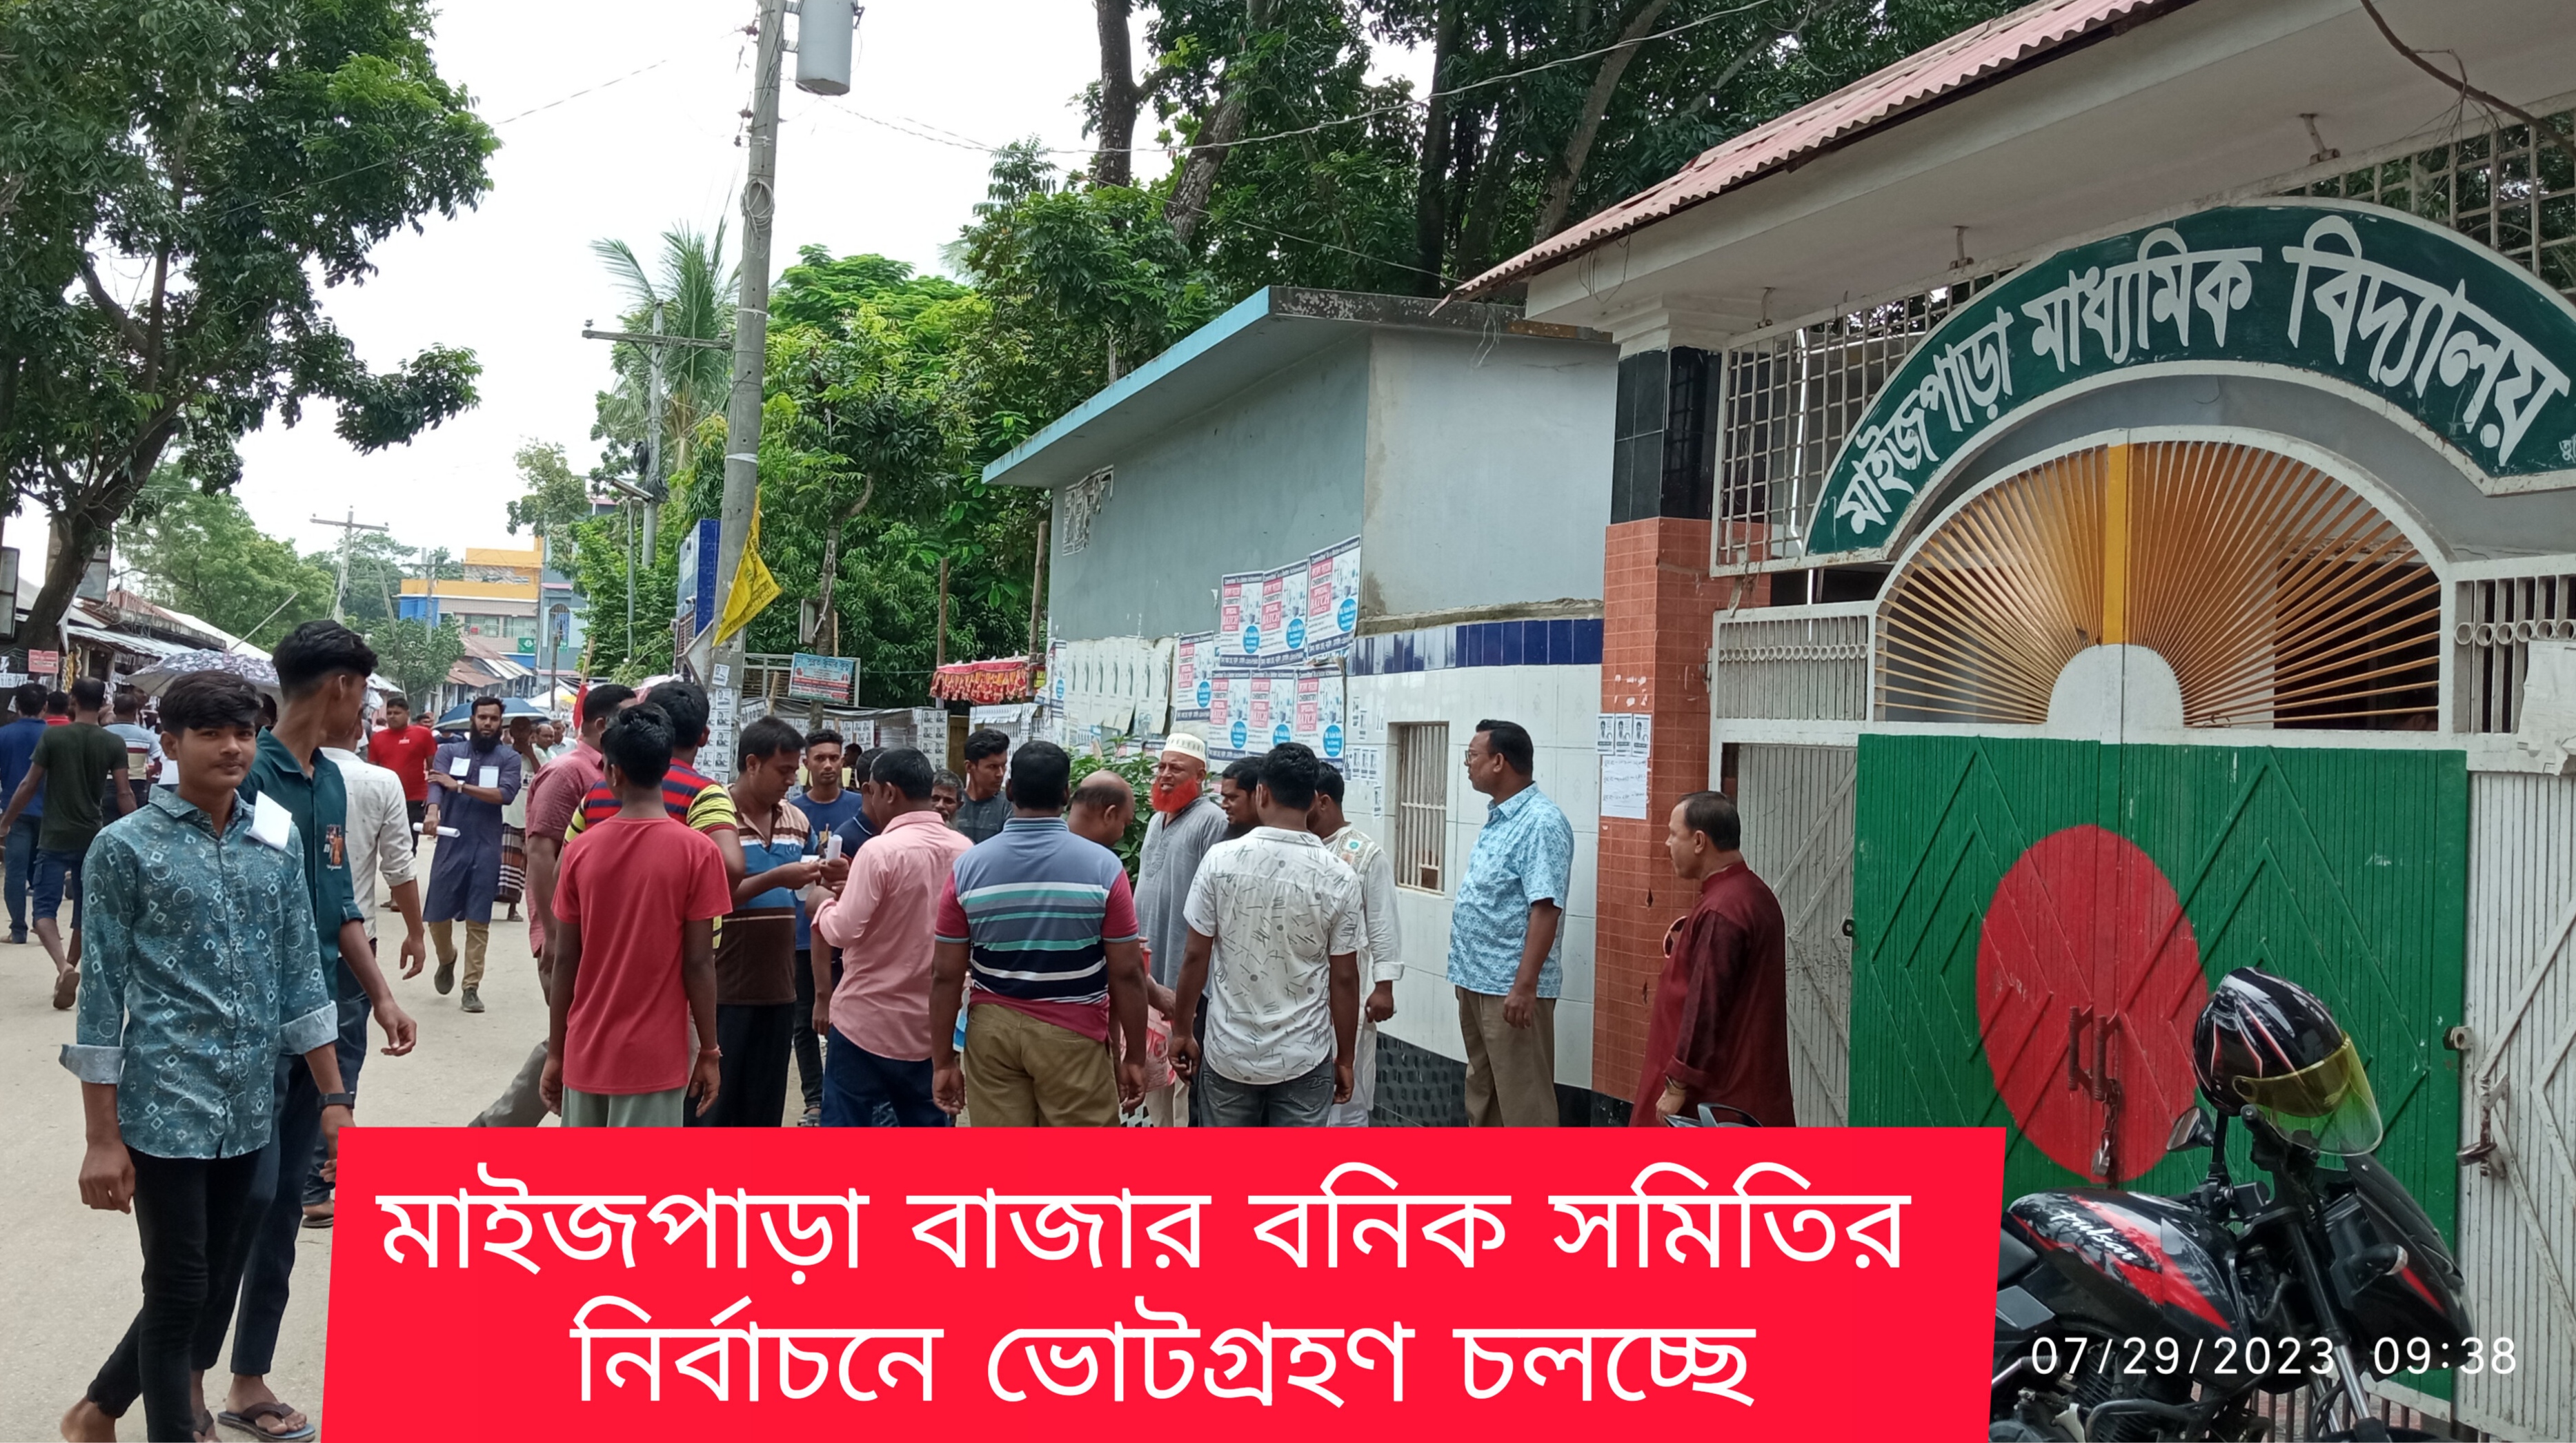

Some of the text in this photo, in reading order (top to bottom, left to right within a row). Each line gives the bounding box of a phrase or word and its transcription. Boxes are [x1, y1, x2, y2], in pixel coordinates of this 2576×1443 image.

[1835, 215, 2571, 534] মাইজপাড়া মাধ্যমিক বিদ্যালয়
[1310, 593, 1330, 609] BATCH
[1297, 713, 1316, 725] BATCH
